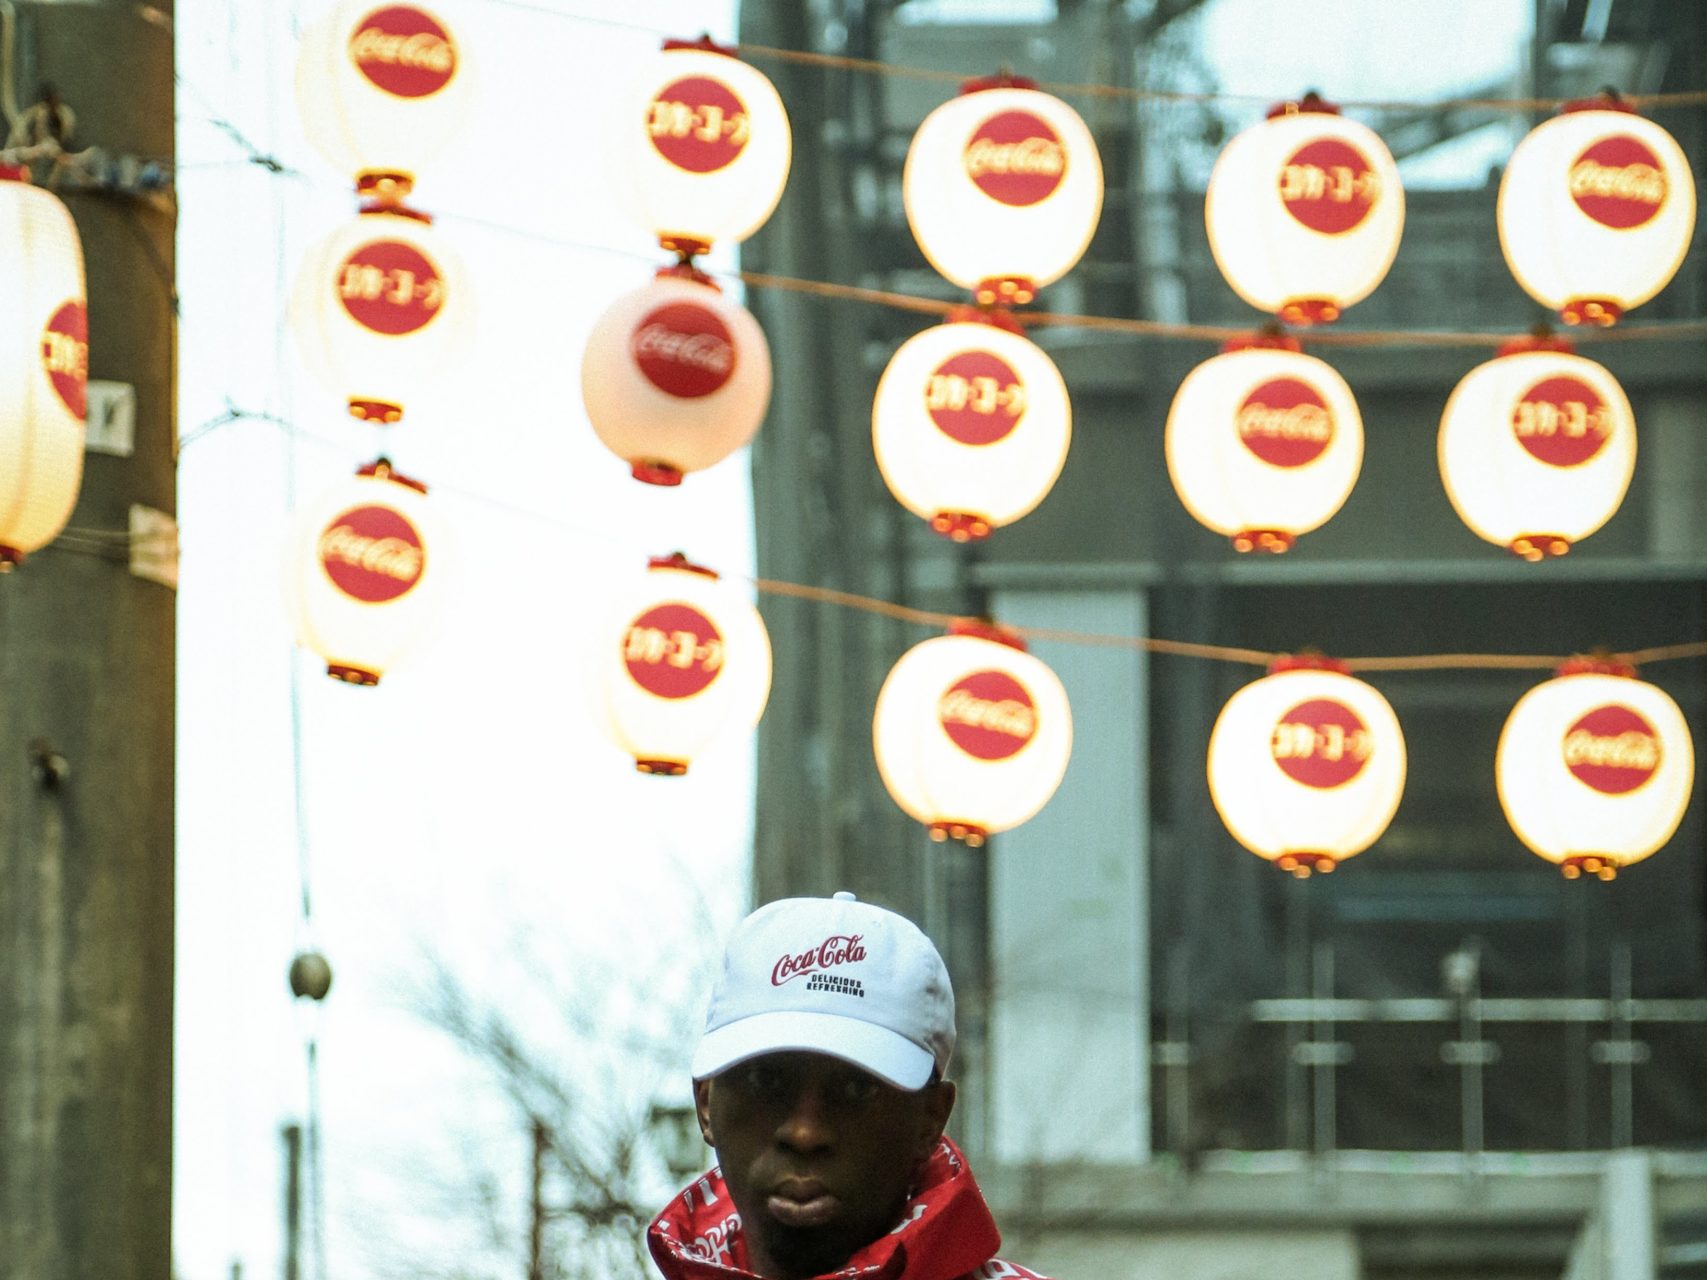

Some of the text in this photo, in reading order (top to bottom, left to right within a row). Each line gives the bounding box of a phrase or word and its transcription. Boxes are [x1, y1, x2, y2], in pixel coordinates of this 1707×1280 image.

[771, 935, 867, 987] Coca-Cola
[811, 974, 862, 988] DELICIOUS
[806, 982, 865, 998] REFRESHING
